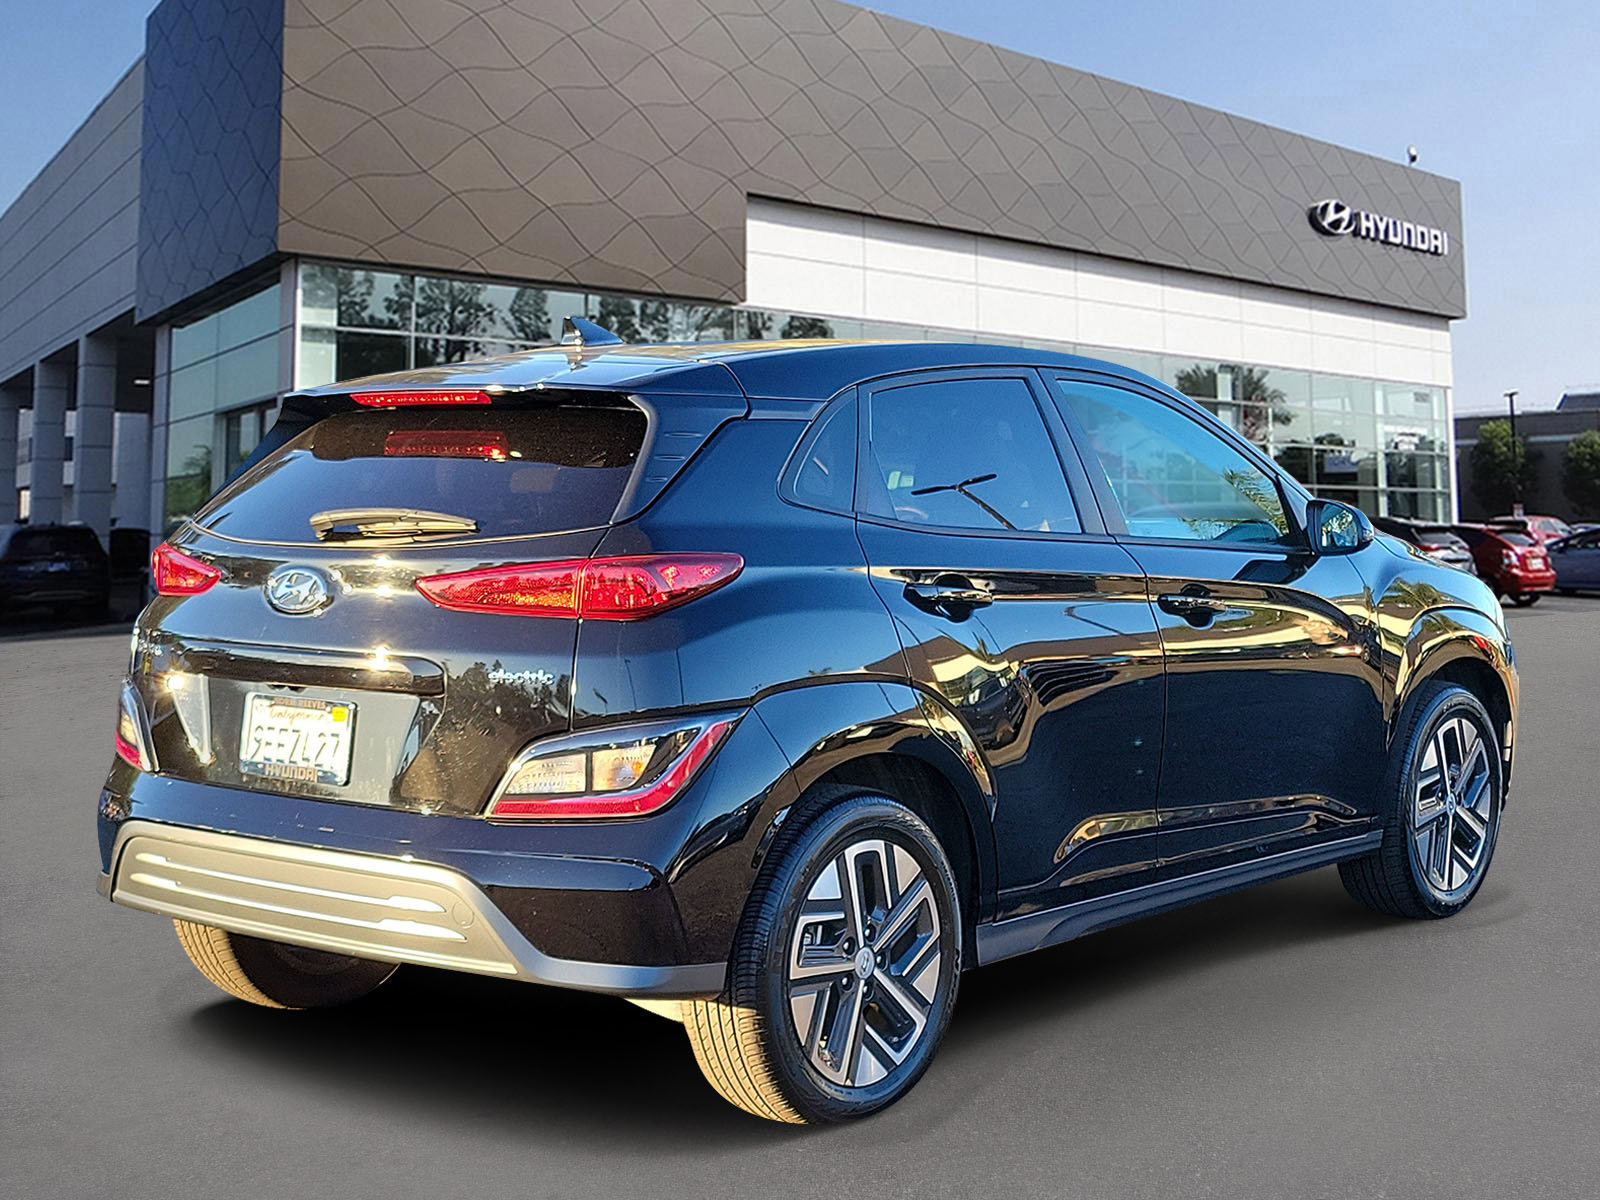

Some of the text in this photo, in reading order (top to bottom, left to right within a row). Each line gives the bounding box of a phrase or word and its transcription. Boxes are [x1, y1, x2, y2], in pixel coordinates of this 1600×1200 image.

[1360, 211, 1448, 255] HYUNDAI
[487, 668, 554, 685] electric
[264, 763, 318, 783] HYUNDAI
